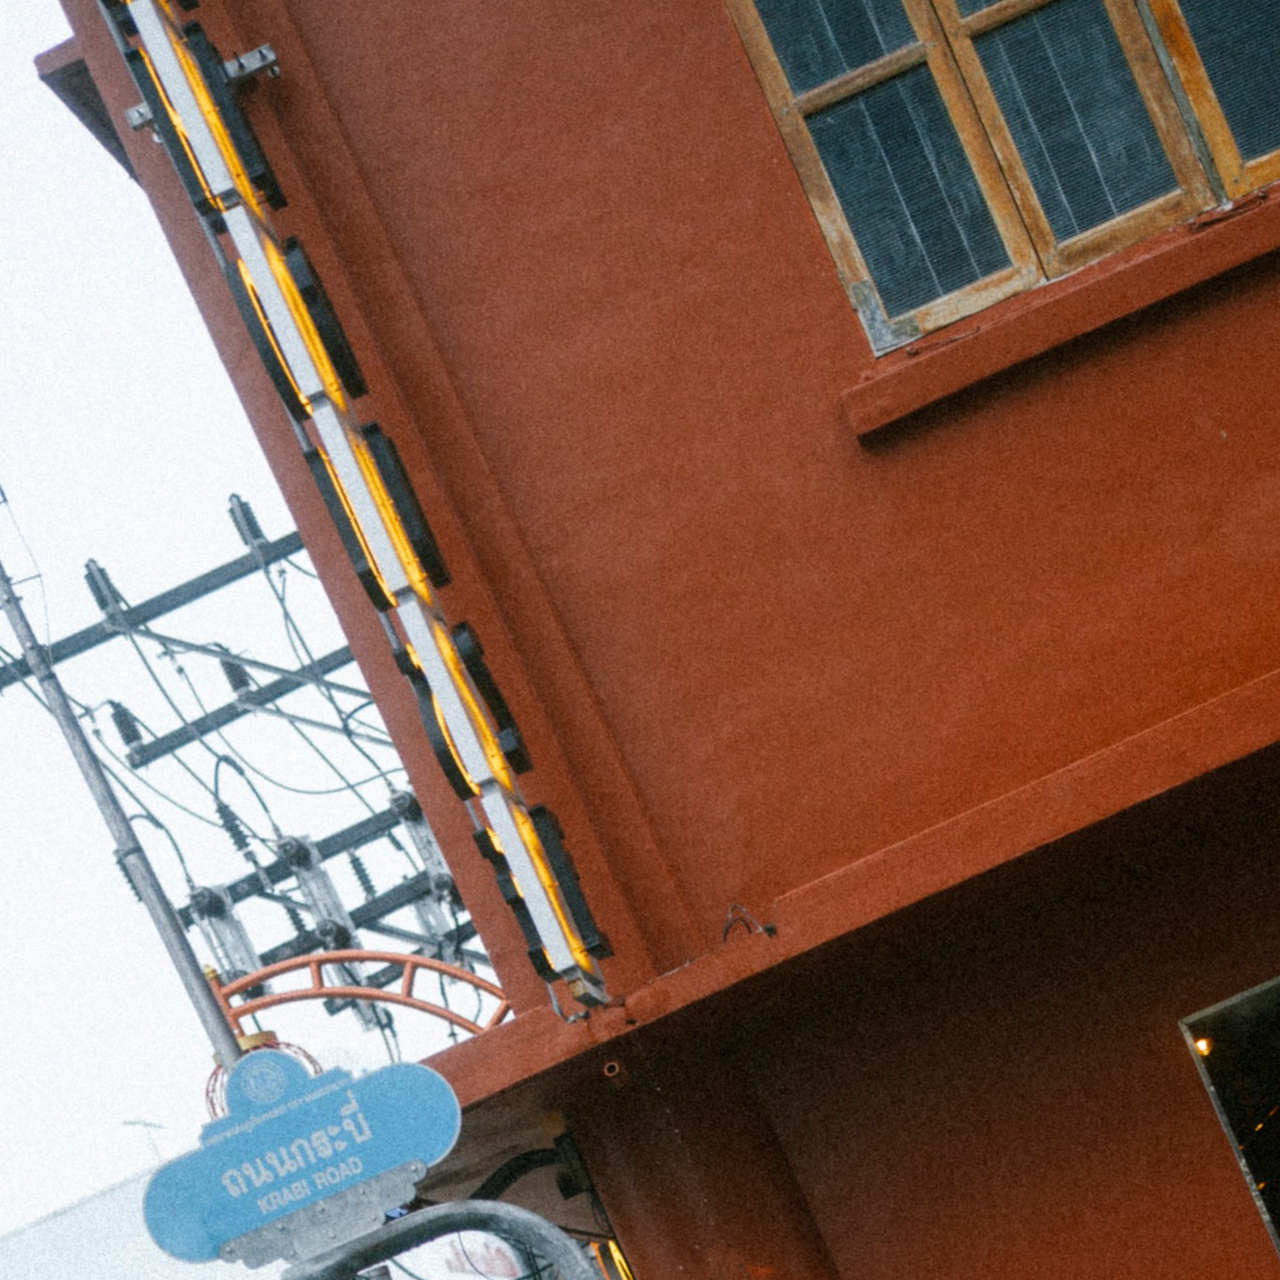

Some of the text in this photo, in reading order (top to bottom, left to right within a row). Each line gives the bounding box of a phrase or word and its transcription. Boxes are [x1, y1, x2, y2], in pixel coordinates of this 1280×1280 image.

[221, 1089, 372, 1198] ถนนกระบี่
[257, 1156, 364, 1215] KRABI ROAD
